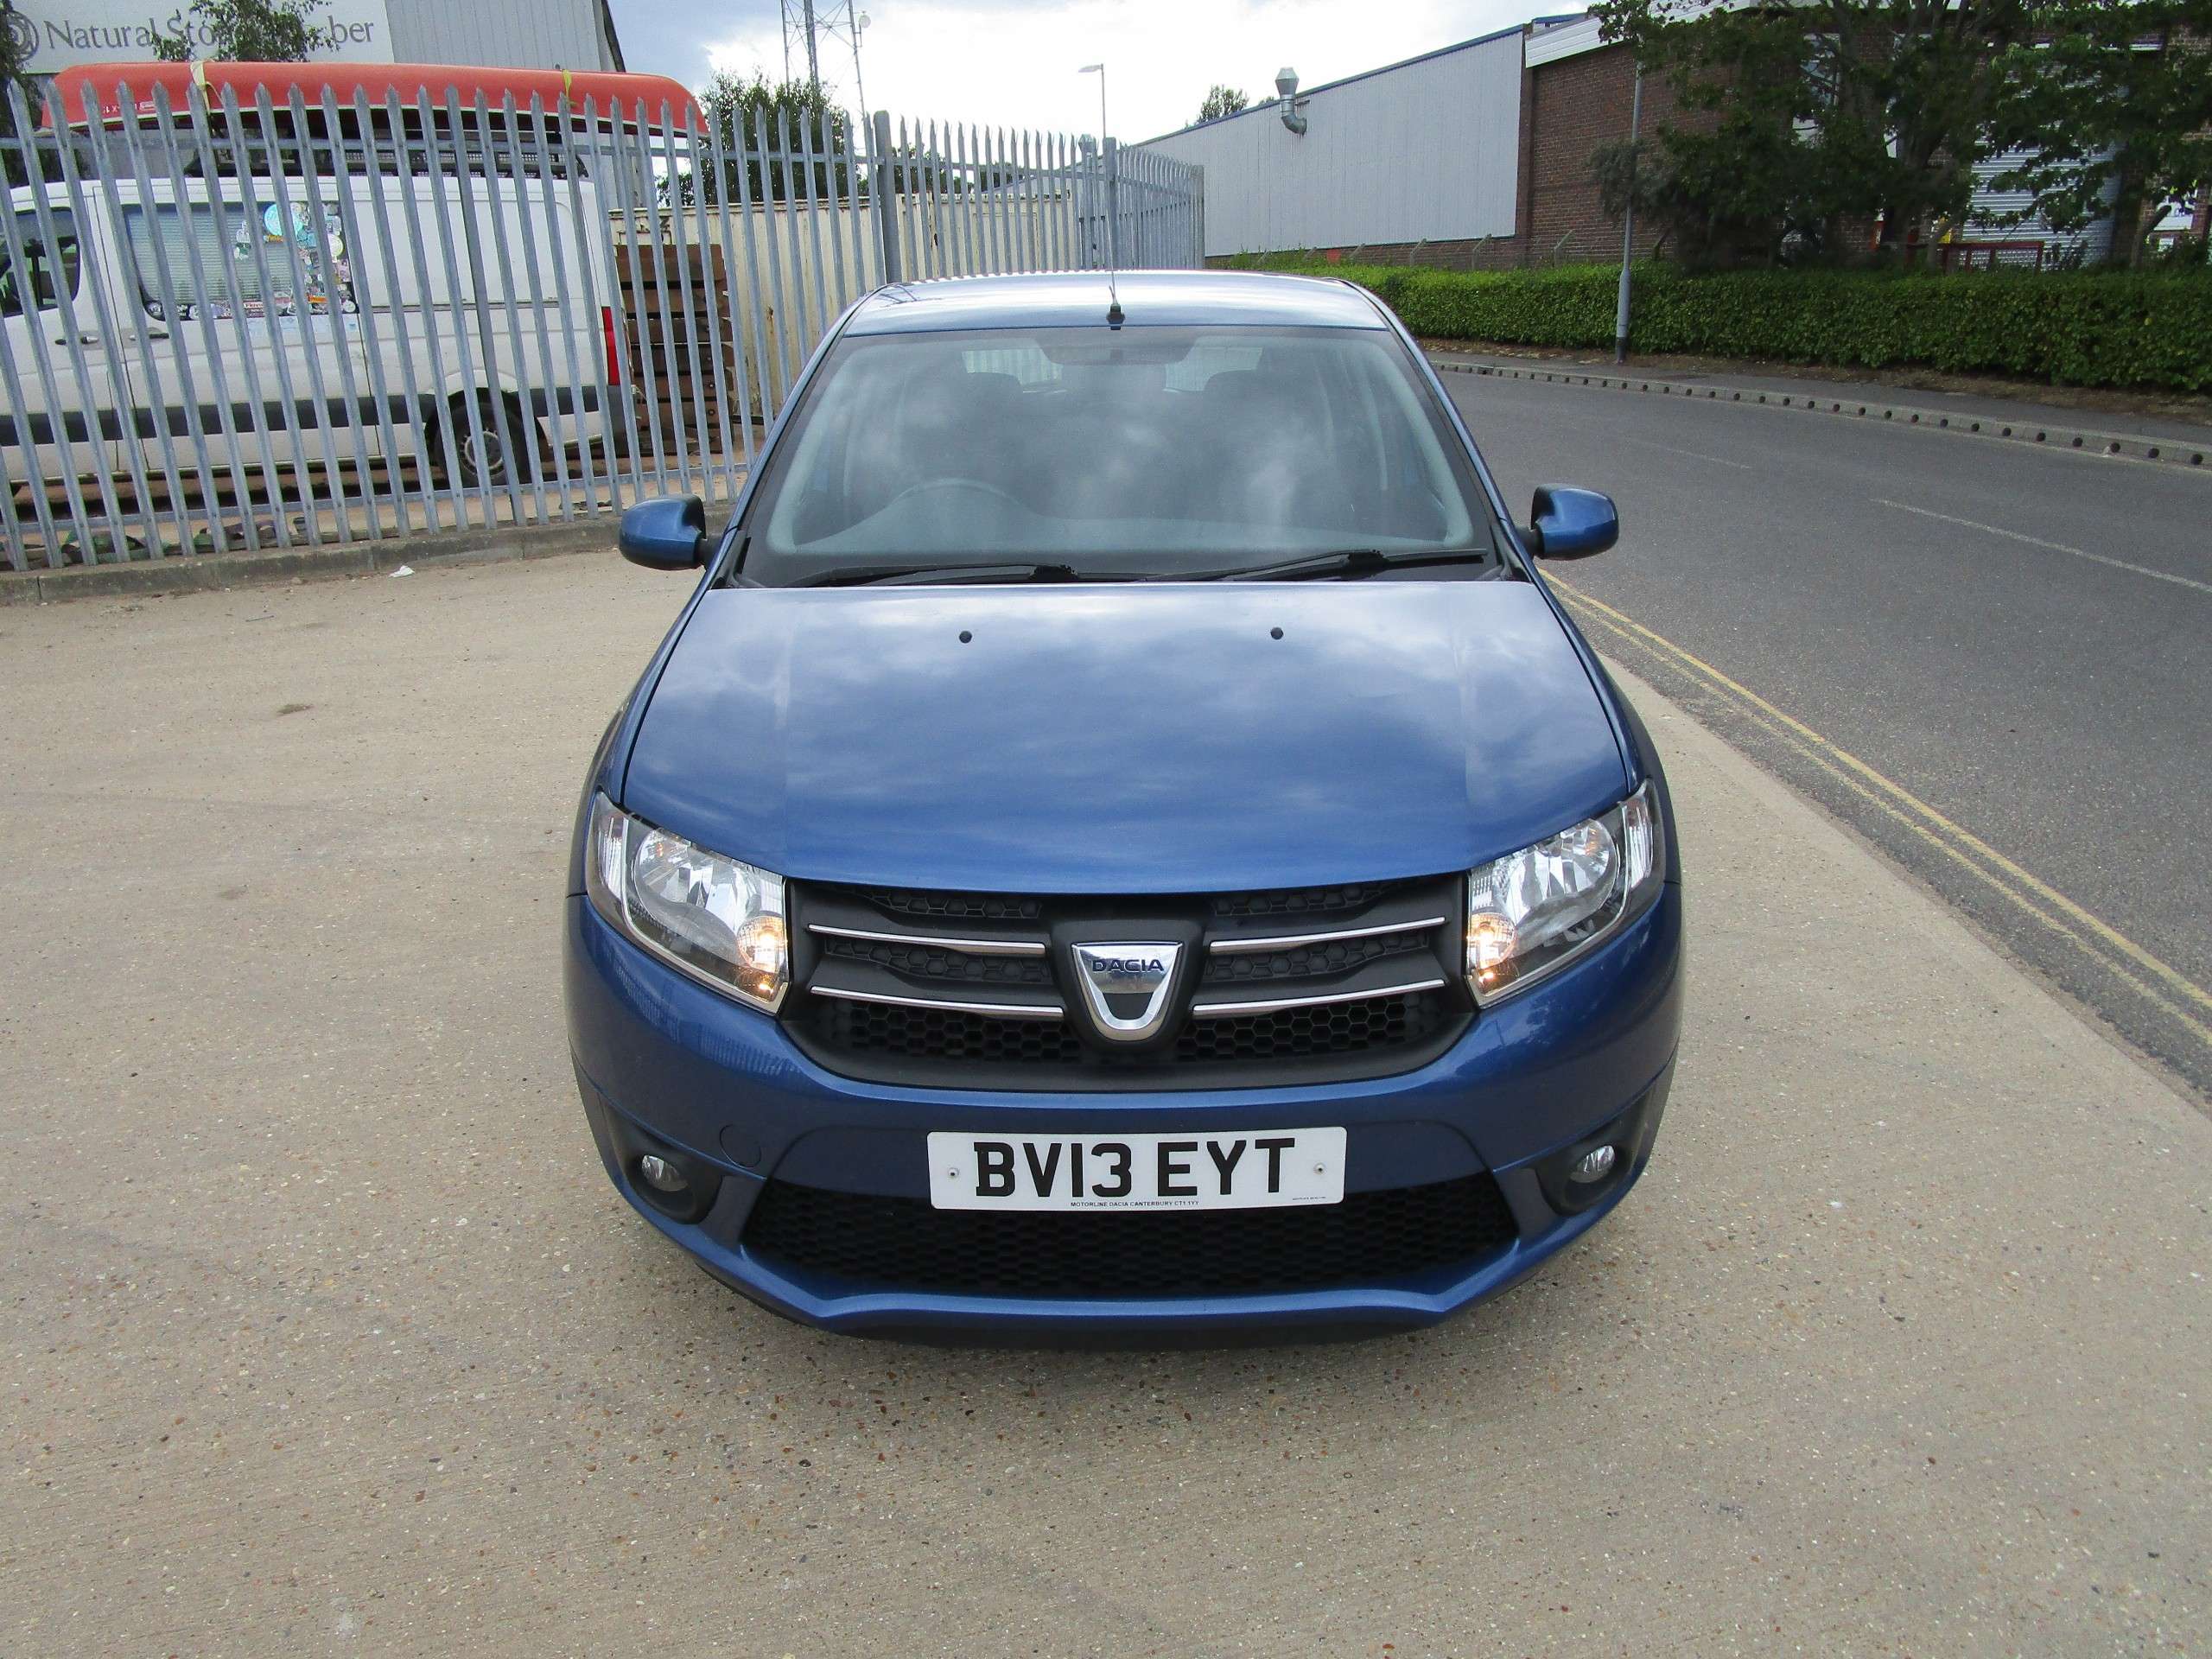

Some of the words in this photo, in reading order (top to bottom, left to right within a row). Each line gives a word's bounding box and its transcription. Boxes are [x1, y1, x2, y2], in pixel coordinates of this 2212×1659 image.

[43, 17, 156, 49] Natural
[1091, 959, 1165, 973] DACIA
[973, 1141, 1133, 1198] BV13
[1157, 1137, 1295, 1197] EYT
